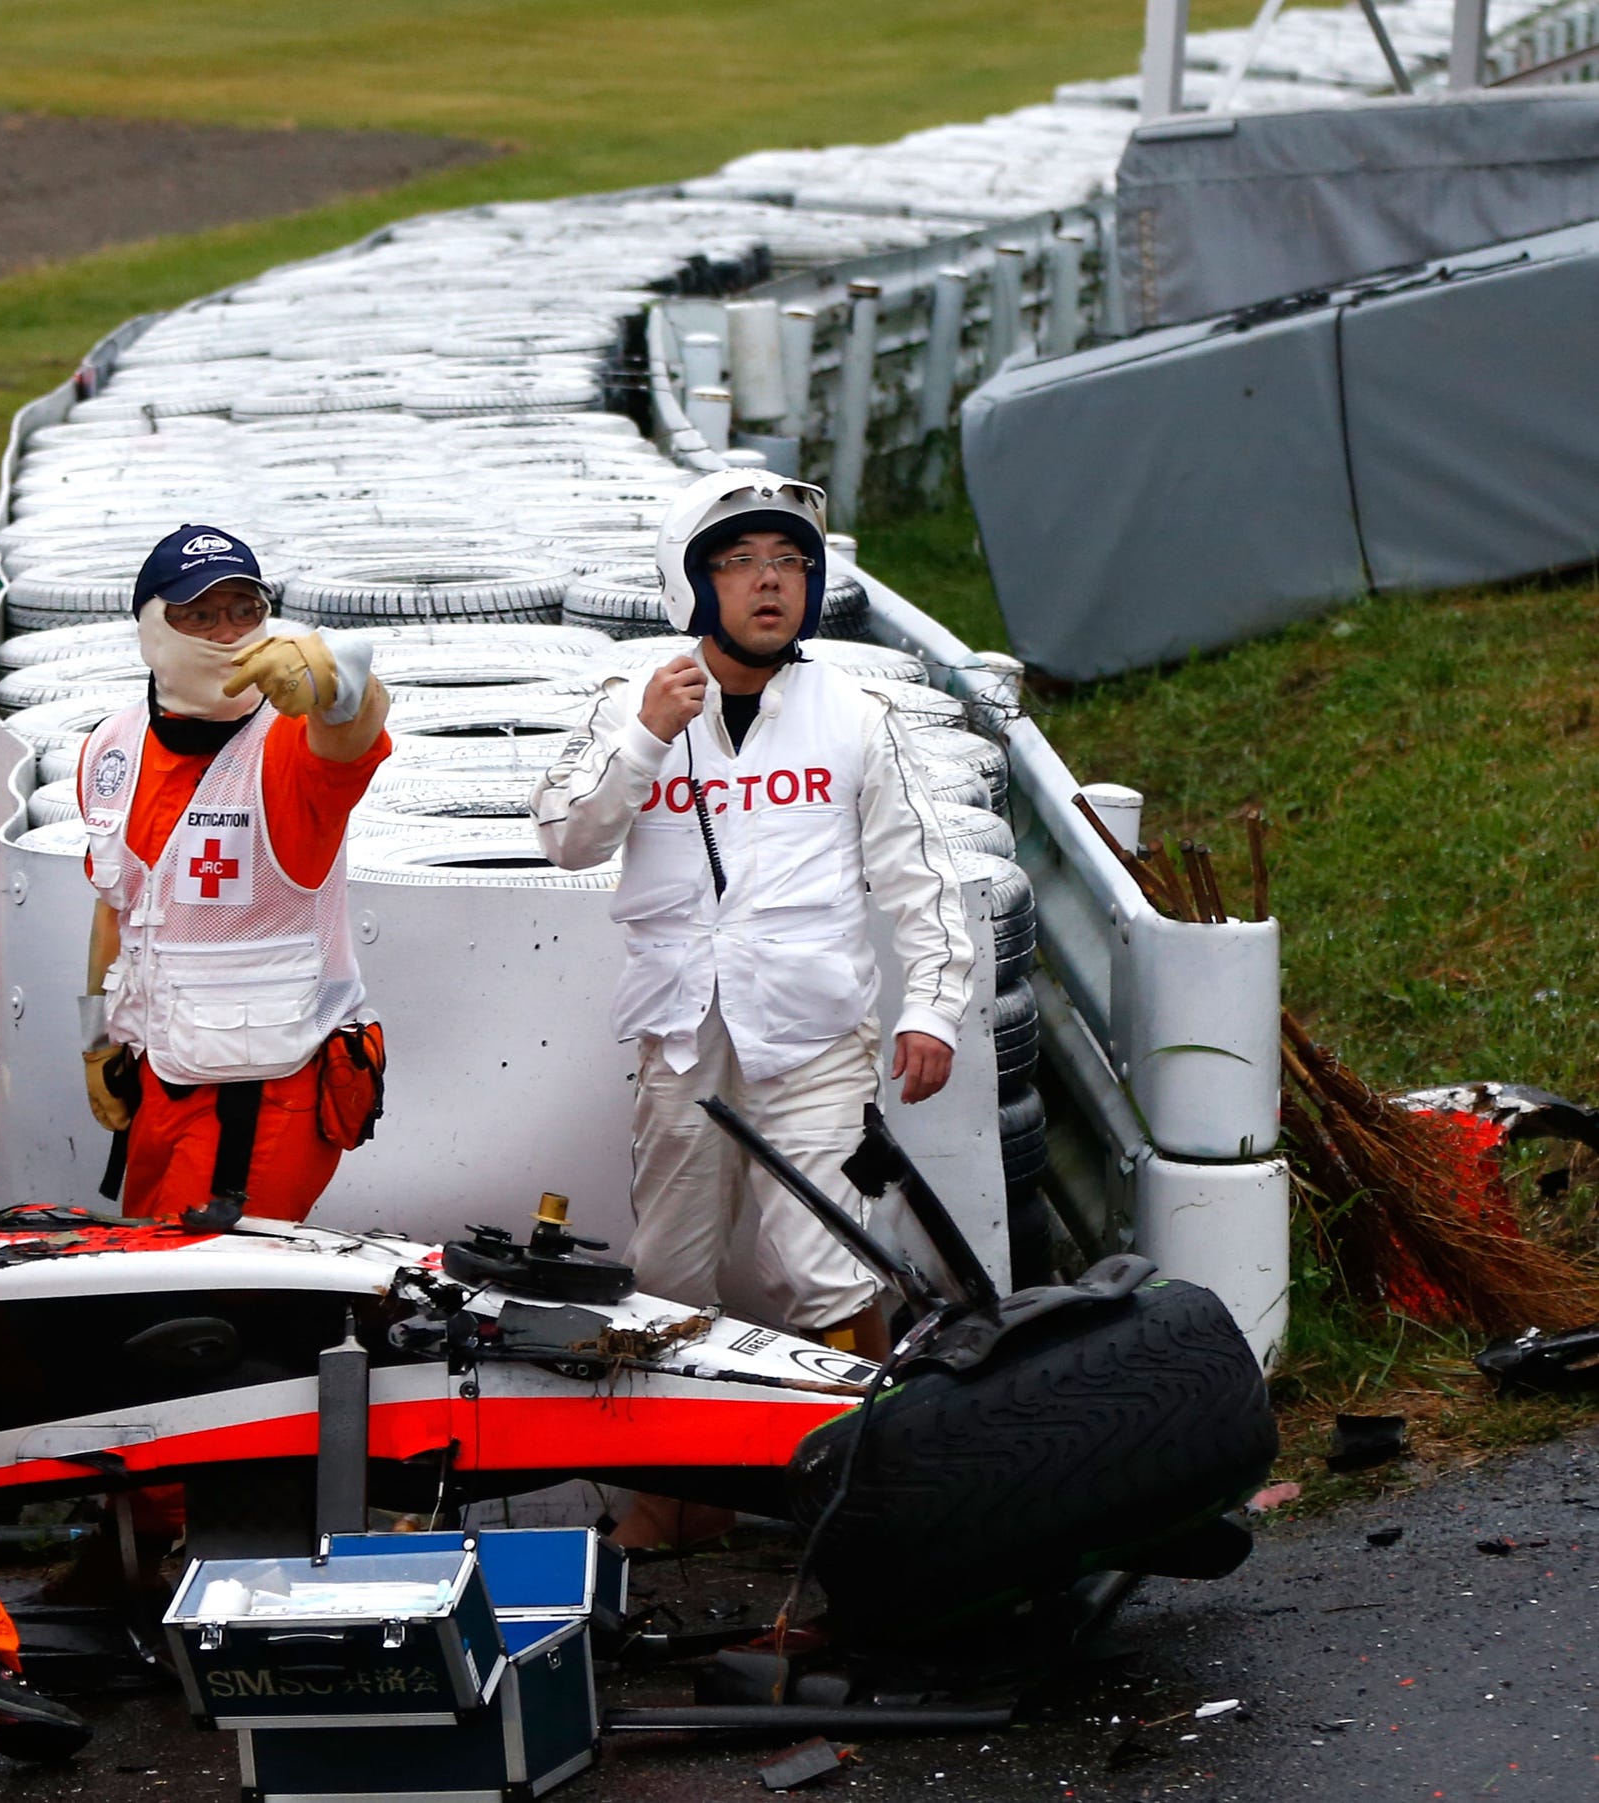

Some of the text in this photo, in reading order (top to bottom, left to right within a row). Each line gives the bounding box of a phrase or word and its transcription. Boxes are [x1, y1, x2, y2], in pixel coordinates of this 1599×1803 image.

[640, 768, 832, 815] DOCTOR
[198, 861, 223, 875] JRC
[728, 1328, 781, 1357] PIRELLI
